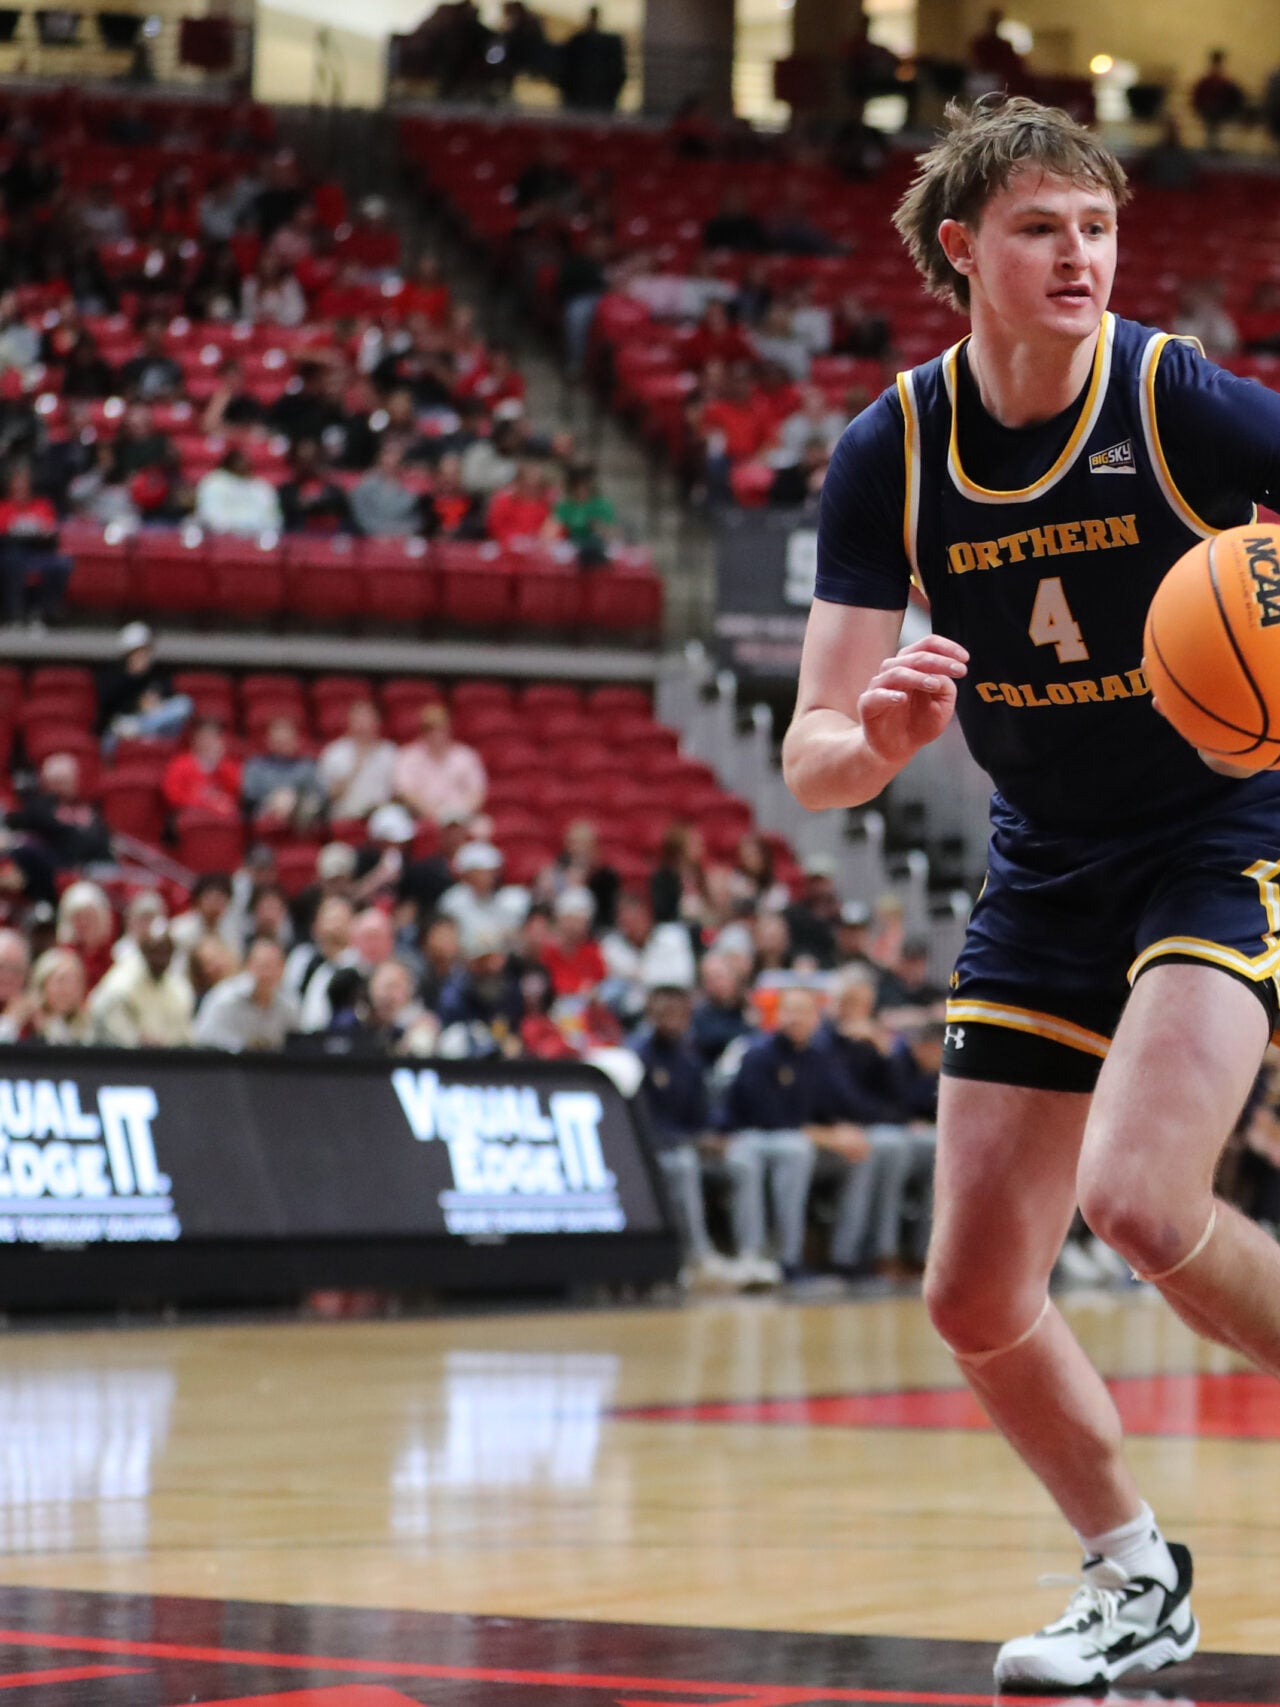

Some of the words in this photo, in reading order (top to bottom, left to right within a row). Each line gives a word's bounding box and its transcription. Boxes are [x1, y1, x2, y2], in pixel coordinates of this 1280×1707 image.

[947, 514, 1140, 574] ORTHERN
[1028, 576, 1090, 664] 4
[975, 667, 1152, 707] COLORAD
